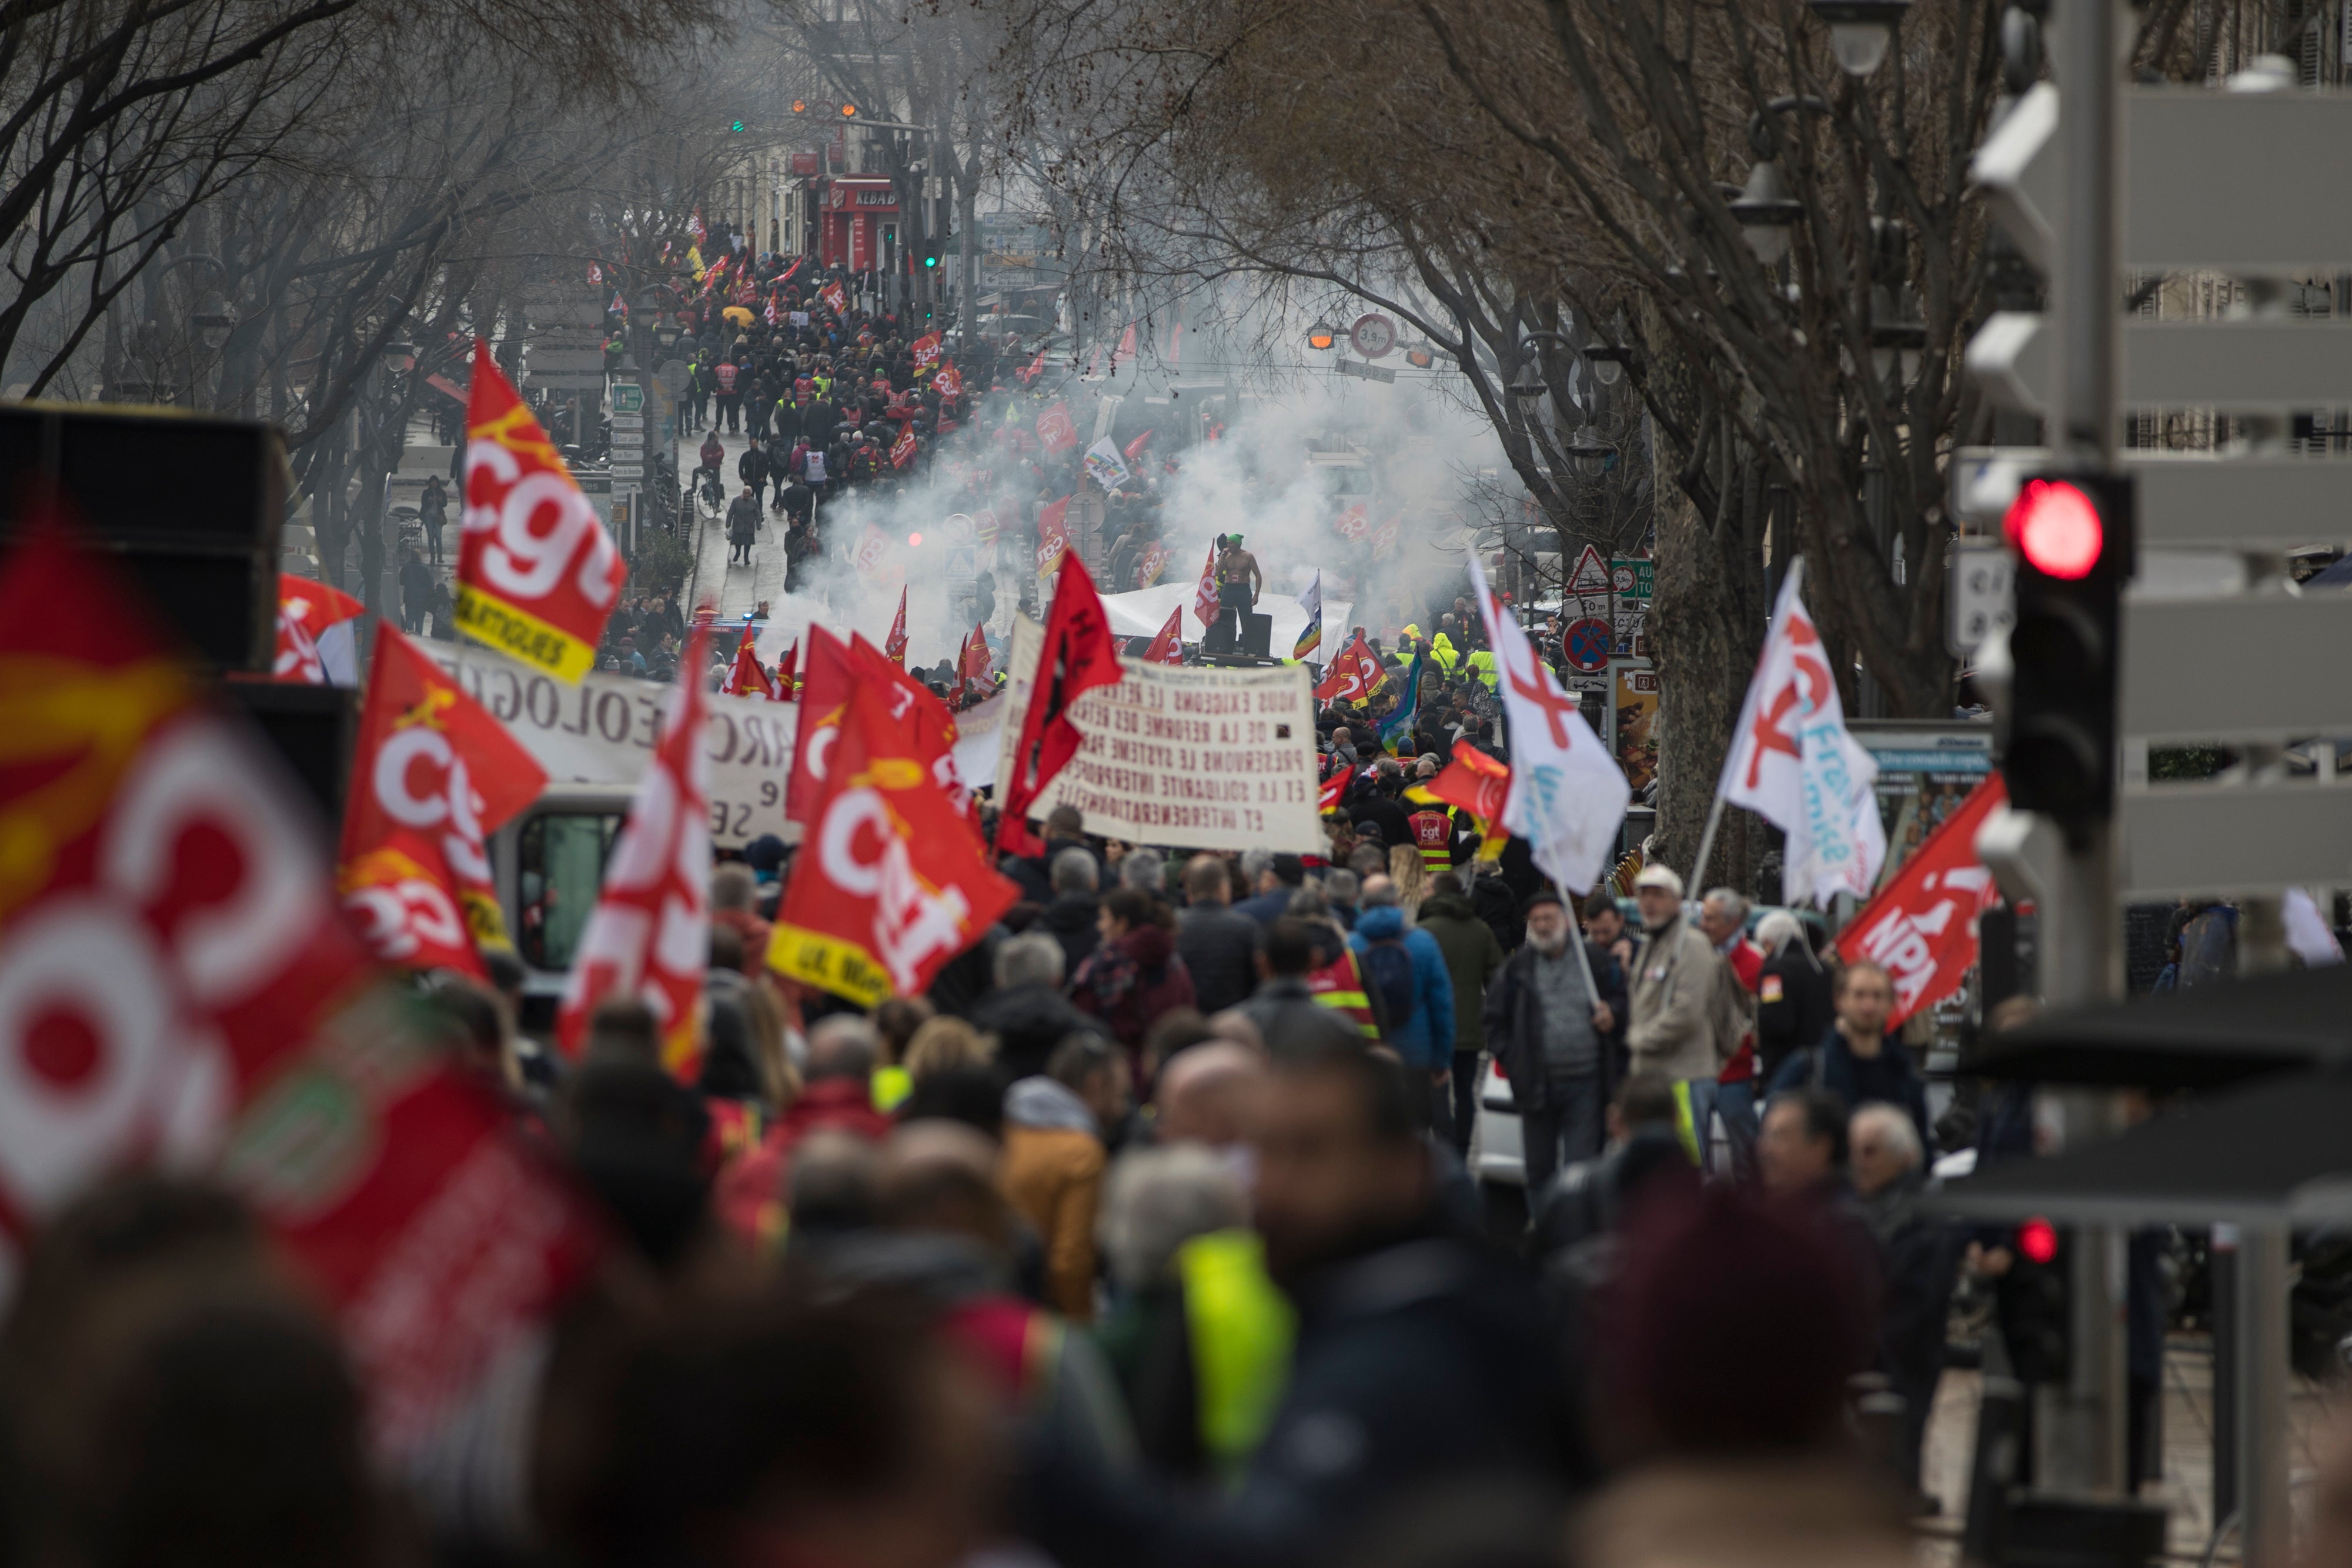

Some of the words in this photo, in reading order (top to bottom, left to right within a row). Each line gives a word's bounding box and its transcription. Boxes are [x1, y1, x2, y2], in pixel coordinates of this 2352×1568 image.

[856, 191, 896, 205] KEBAB
[1359, 366, 1379, 377] 500
[1422, 826, 1439, 839] cgt
[1862, 906, 1939, 1017] NPA
